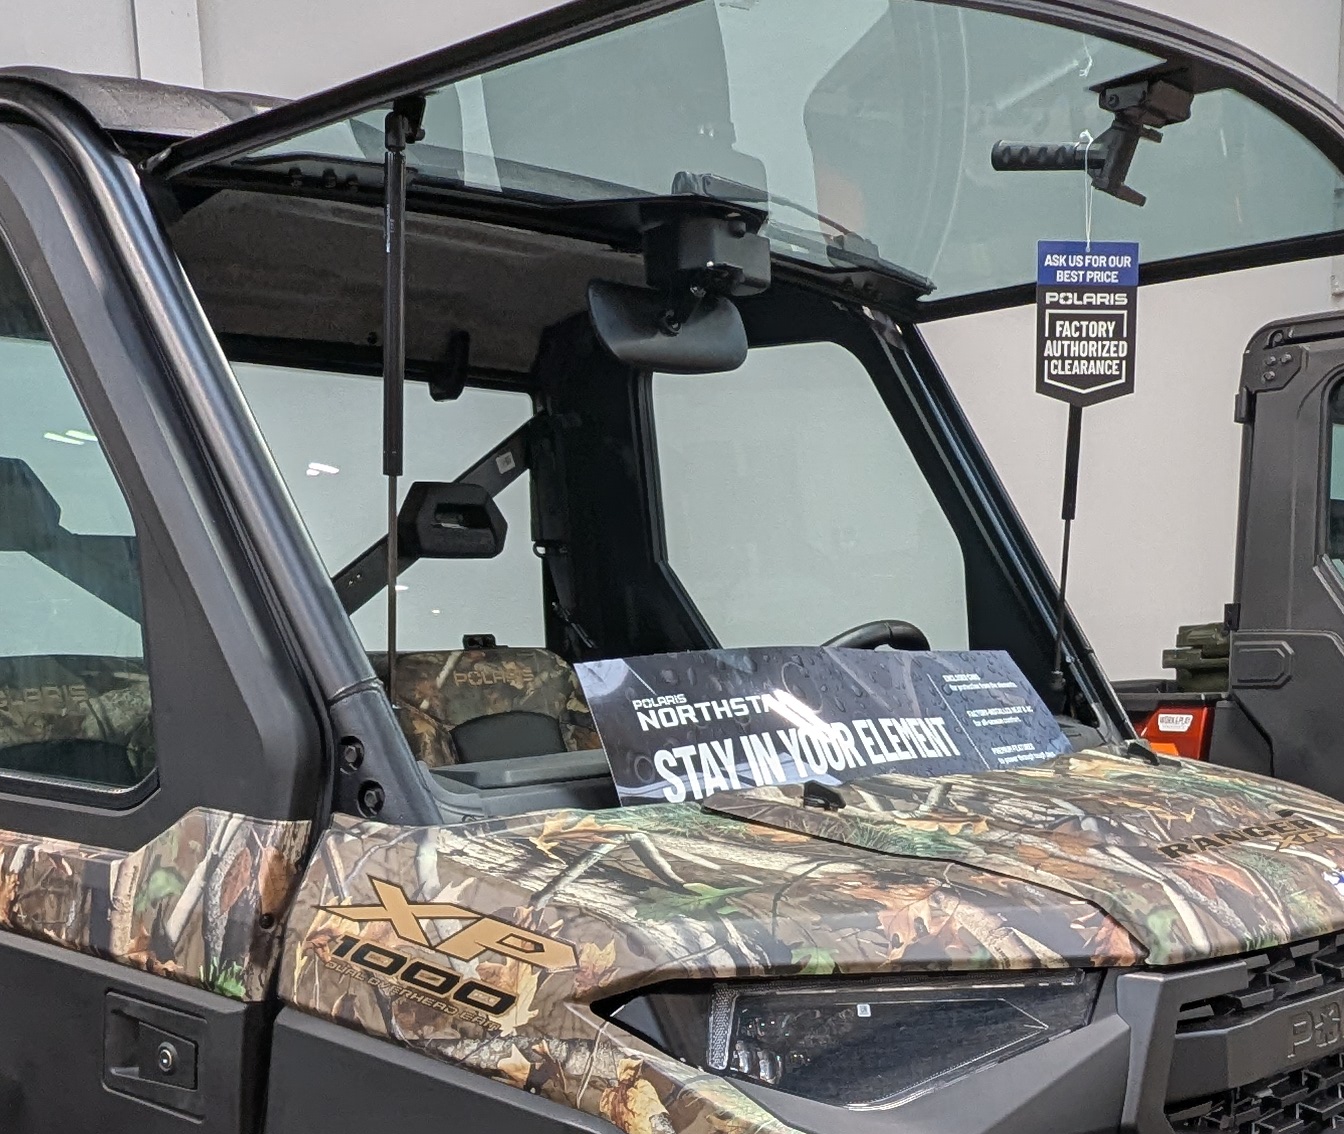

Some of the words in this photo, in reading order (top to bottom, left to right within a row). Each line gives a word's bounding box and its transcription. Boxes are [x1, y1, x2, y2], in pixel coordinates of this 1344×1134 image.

[1044, 254, 1066, 267] ASK
[1068, 255, 1084, 267] US
[1085, 255, 1107, 267] FOR
[1108, 255, 1131, 268] OUR
[1056, 270, 1085, 282] BEST
[1086, 271, 1118, 283] PRICE
[1045, 292, 1128, 305] POLARIS
[1055, 320, 1116, 338] FACTORY
[1044, 340, 1127, 357] AUTHORIZED
[1050, 359, 1120, 375] CLEARANCE
[453, 666, 534, 687] POLARIS
[632, 693, 687, 710] POLARIS
[654, 738, 742, 803] STAY
[740, 732, 787, 787] IN
[776, 722, 866, 778] YOUR
[852, 717, 960, 765] ELEMENT
[1158, 818, 1320, 859] RANGER
[1276, 828, 1330, 851] XP
[311, 873, 579, 970] XP
[331, 934, 518, 1016] 1000
[325, 961, 365, 981] DUAL
[367, 975, 460, 1015] OVERHEAD
